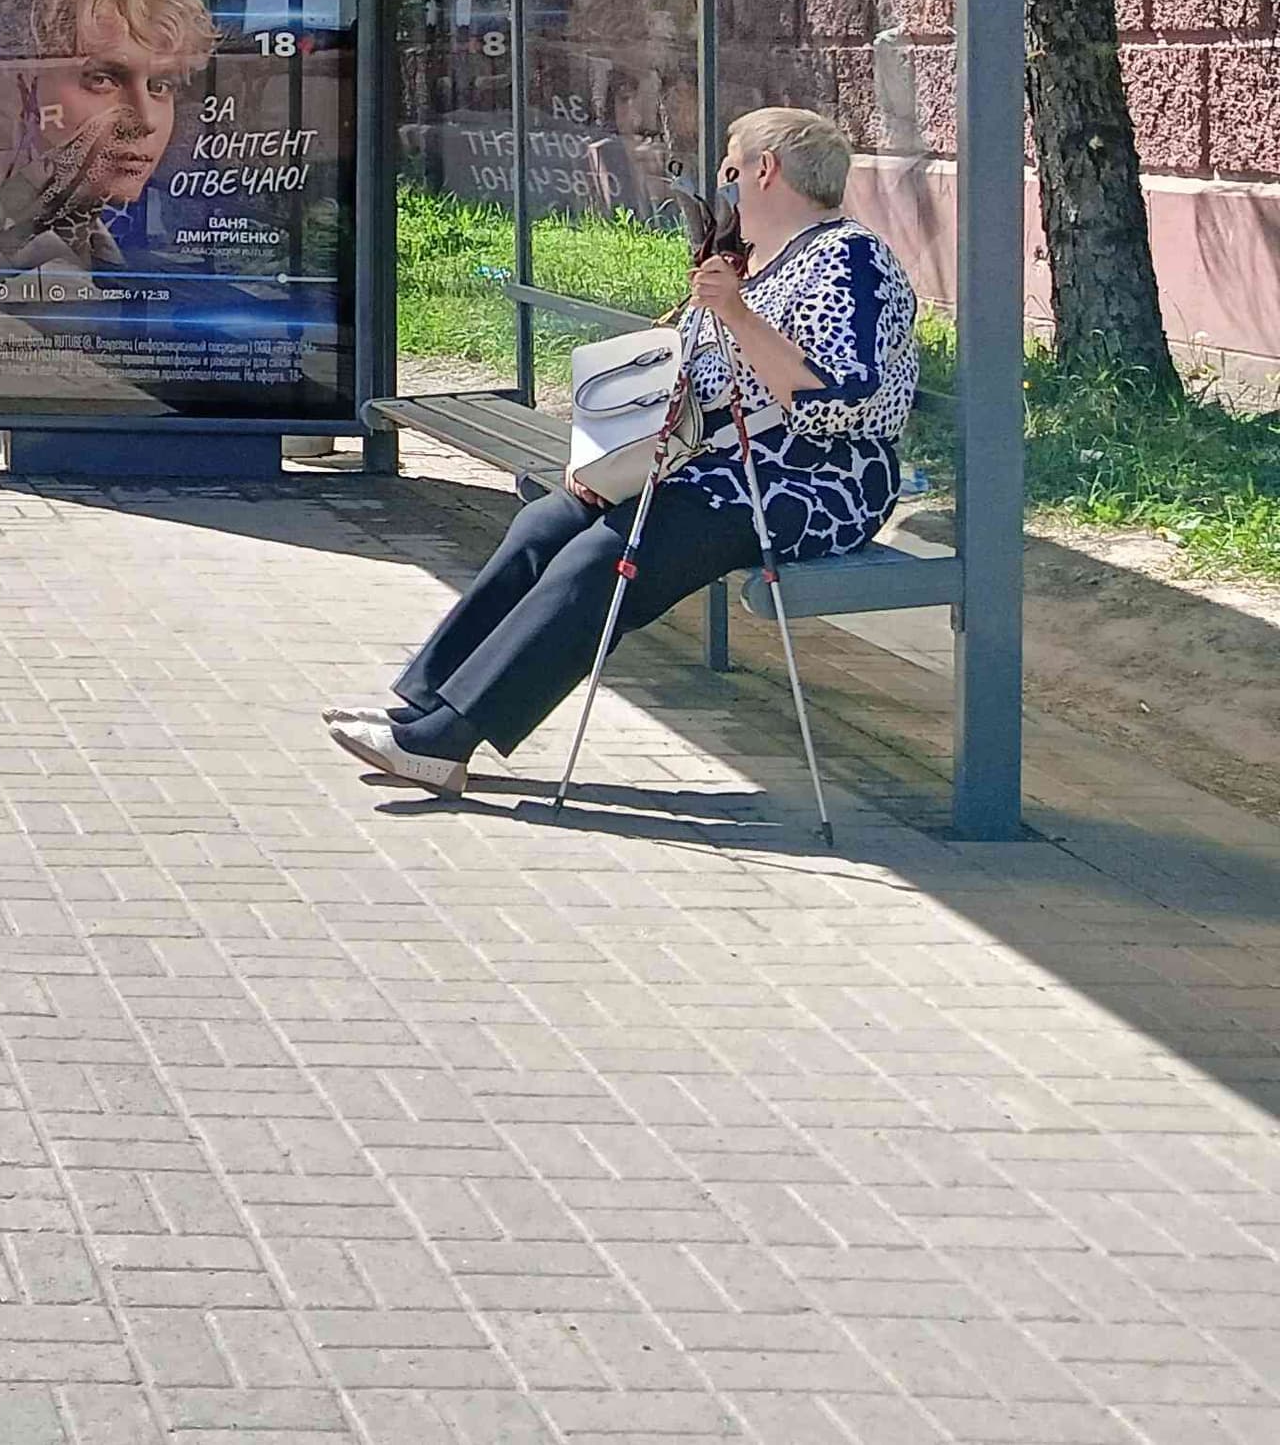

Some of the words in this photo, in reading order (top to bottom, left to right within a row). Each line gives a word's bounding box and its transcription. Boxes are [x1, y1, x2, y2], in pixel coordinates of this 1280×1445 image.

[199, 96, 235, 123] ЗА
[193, 129, 318, 160] КОНТЕНТ
[170, 164, 309, 197] ОТВЕЧАЮ!
[208, 217, 248, 229] ВАНЯ
[176, 230, 280, 244] ДМИТРИЕНКО
